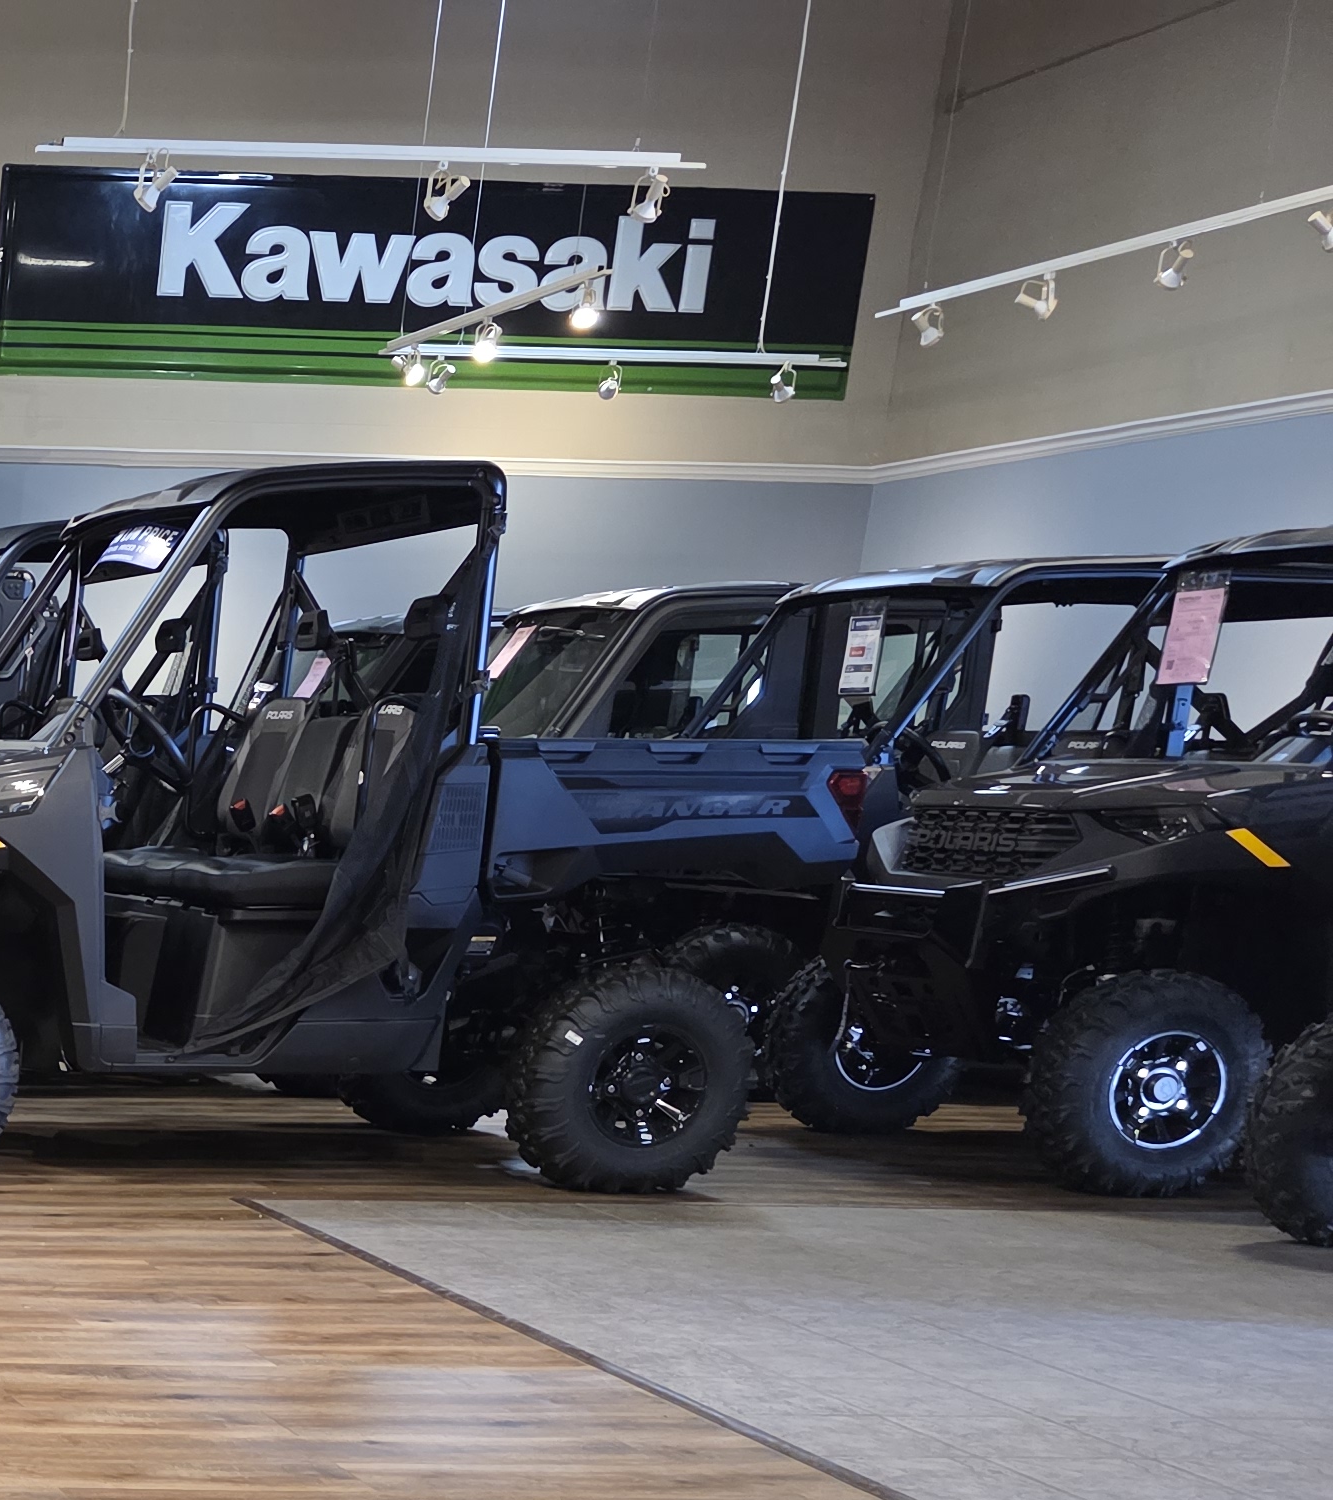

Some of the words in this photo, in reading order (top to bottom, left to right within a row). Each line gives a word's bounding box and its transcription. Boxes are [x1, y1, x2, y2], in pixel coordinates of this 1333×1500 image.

[156, 200, 717, 314] Kawasaki
[378, 705, 405, 716] LARIS
[623, 799, 791, 818] ANGER
[914, 829, 1018, 852] POLARIS
